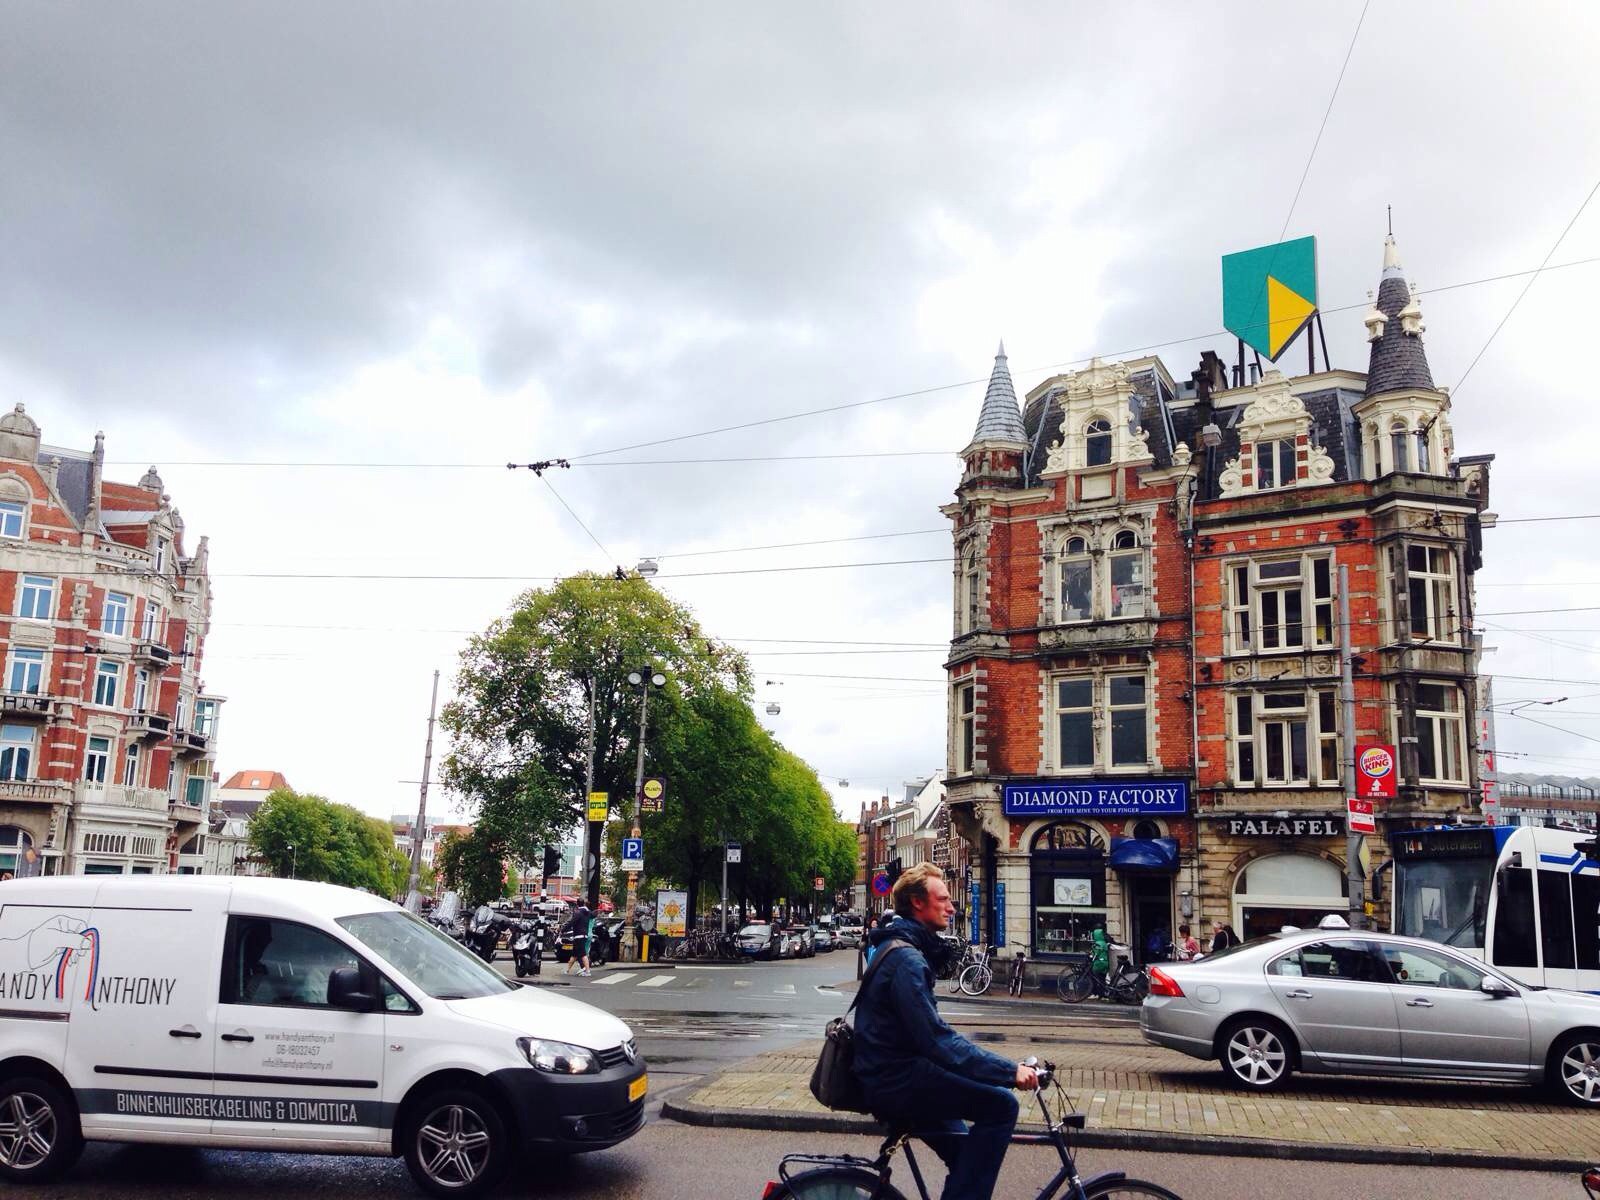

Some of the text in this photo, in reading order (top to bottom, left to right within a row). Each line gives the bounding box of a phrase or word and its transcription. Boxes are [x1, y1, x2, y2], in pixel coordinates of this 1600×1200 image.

[1363, 753, 1388, 764] BURGER
[1364, 759, 1390, 772] KING
[1012, 788, 1179, 807] DIAMOND FACTORY
[1229, 820, 1338, 835] FALAFEL
[627, 841, 638, 858] P
[1403, 839, 1415, 854] 14
[116, 1092, 358, 1123] BINNENHUISBEKABELING & DOMOTICA
